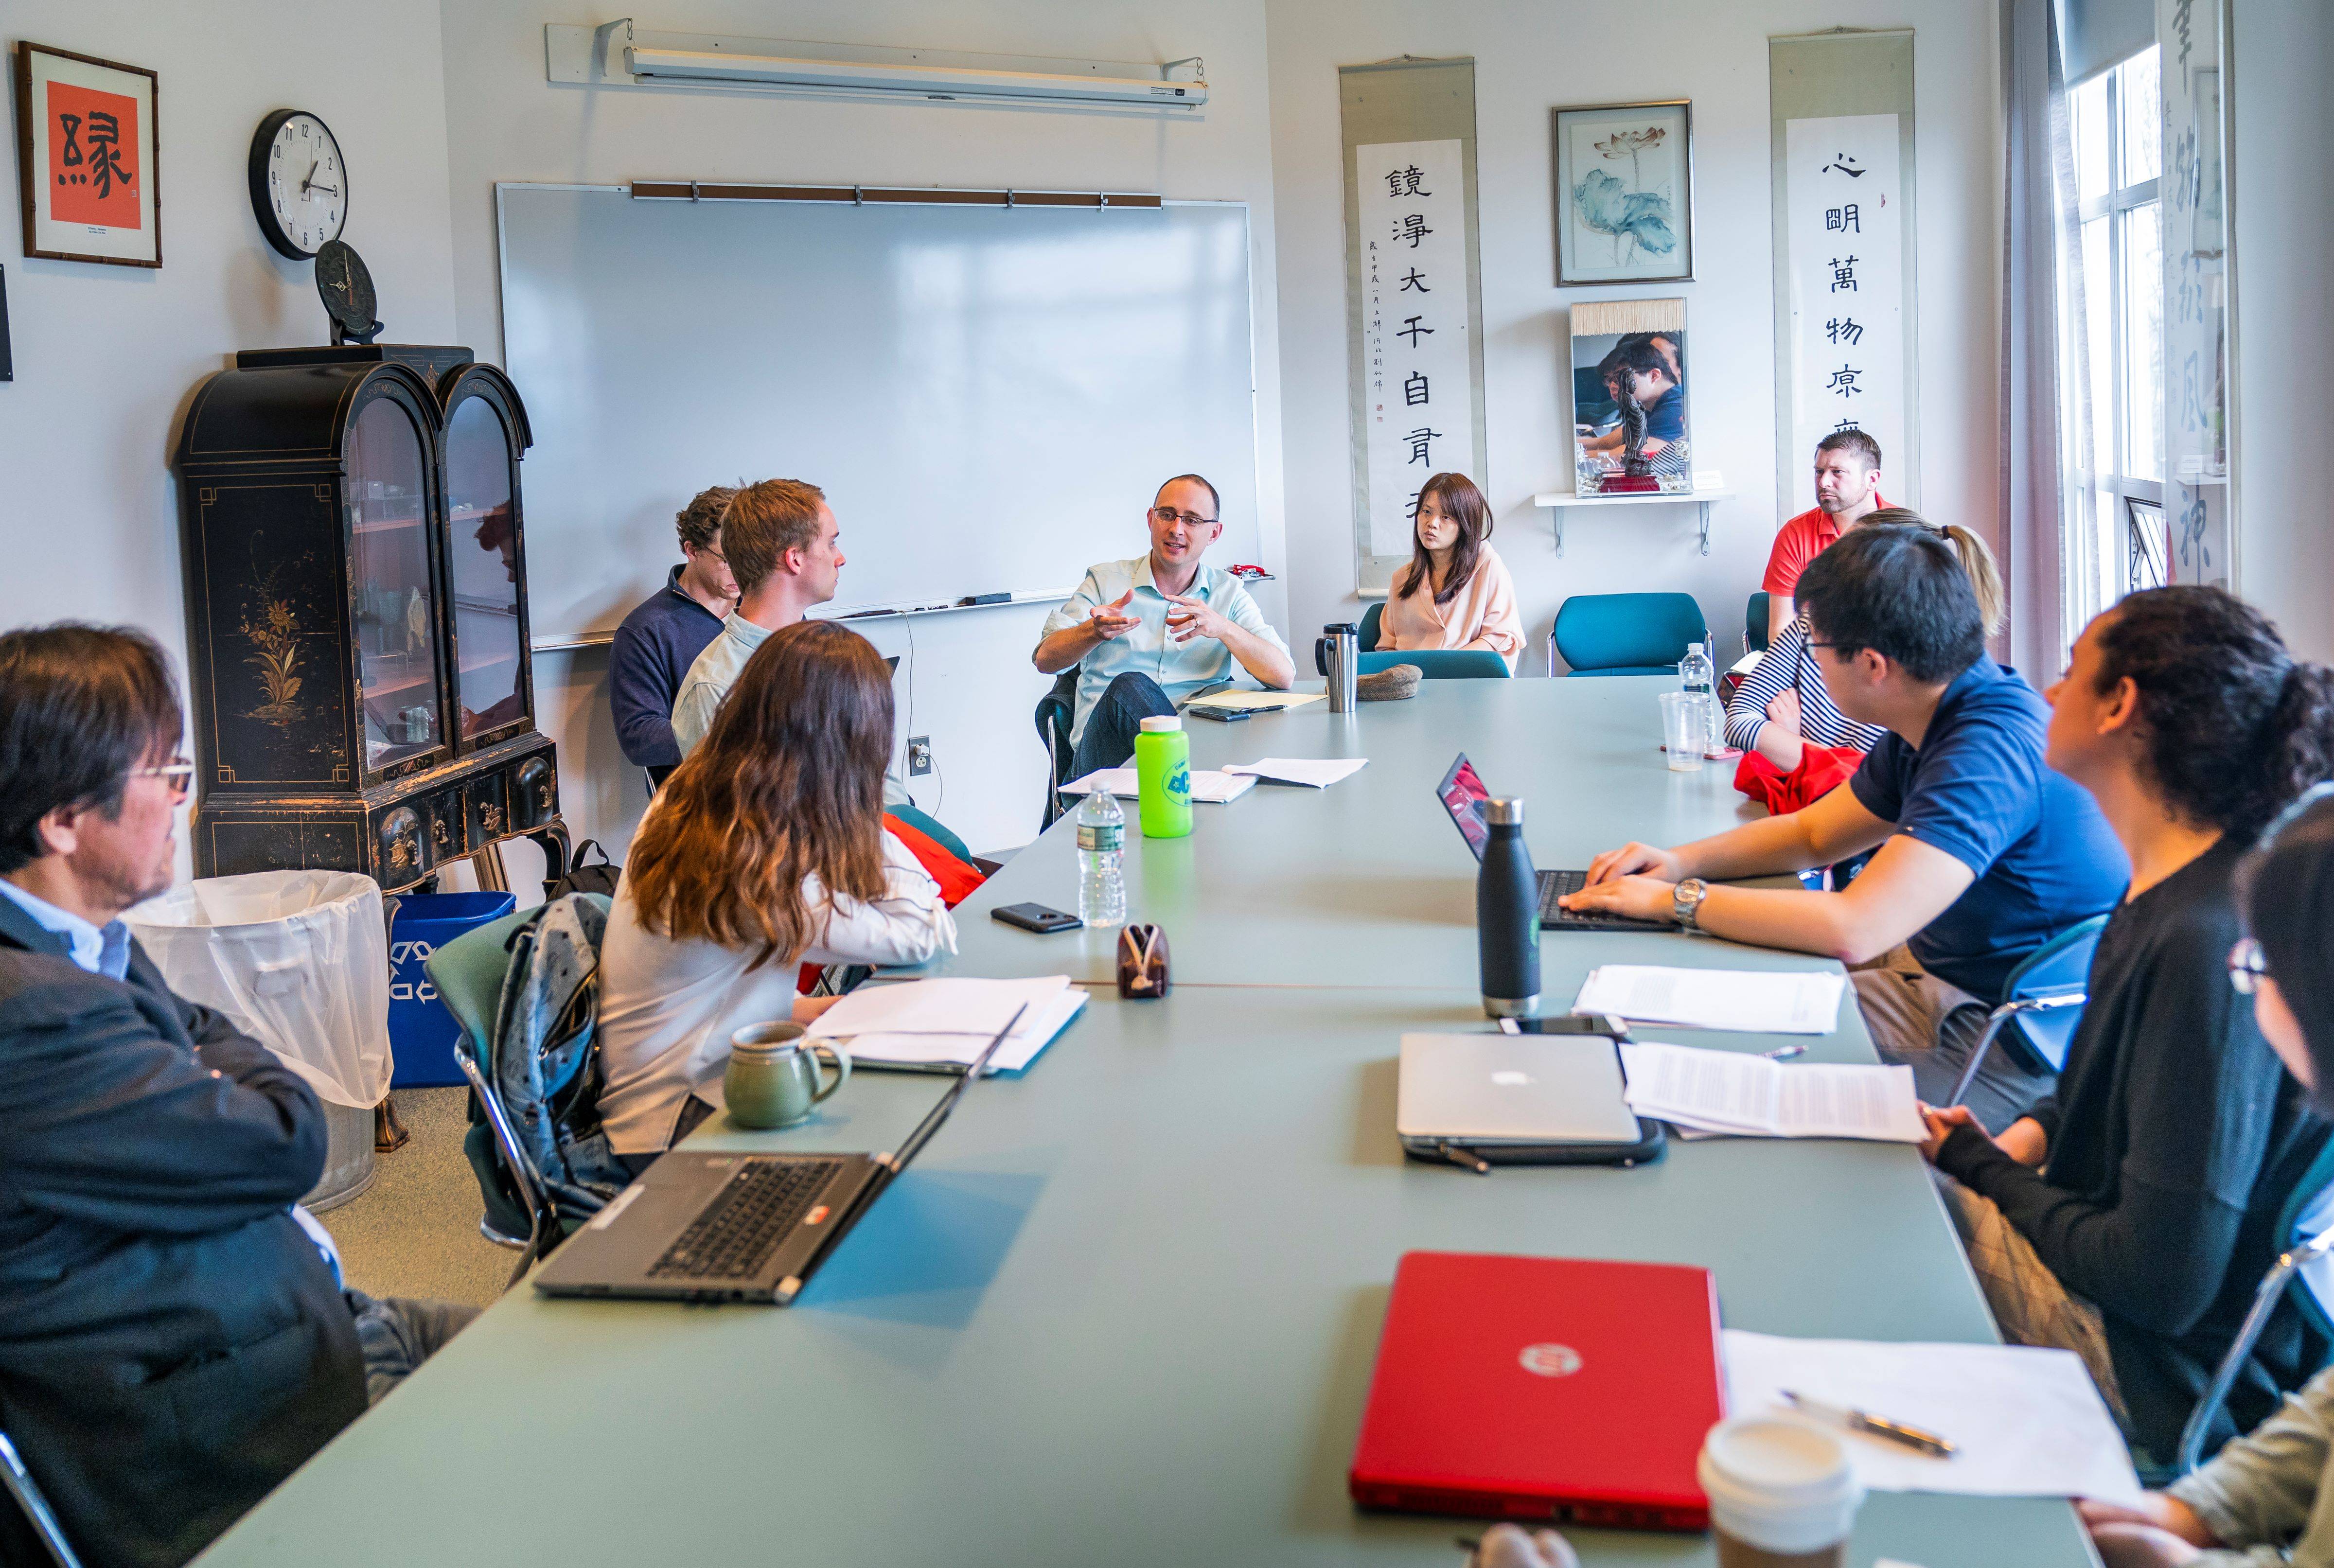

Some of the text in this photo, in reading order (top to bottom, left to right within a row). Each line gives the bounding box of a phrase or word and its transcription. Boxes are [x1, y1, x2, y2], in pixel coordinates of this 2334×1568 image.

[286, 127, 292, 141] 11
[302, 124, 309, 138] 12
[318, 136, 321, 148] 1
[274, 145, 280, 158] 10
[328, 158, 332, 170] 2
[272, 171, 276, 185] 9
[334, 185, 338, 198] 3
[277, 200, 281, 213] 8
[330, 211, 335, 223] 4
[289, 223, 292, 236] 7
[319, 228, 323, 241] 5
[303, 232, 308, 246] 6
